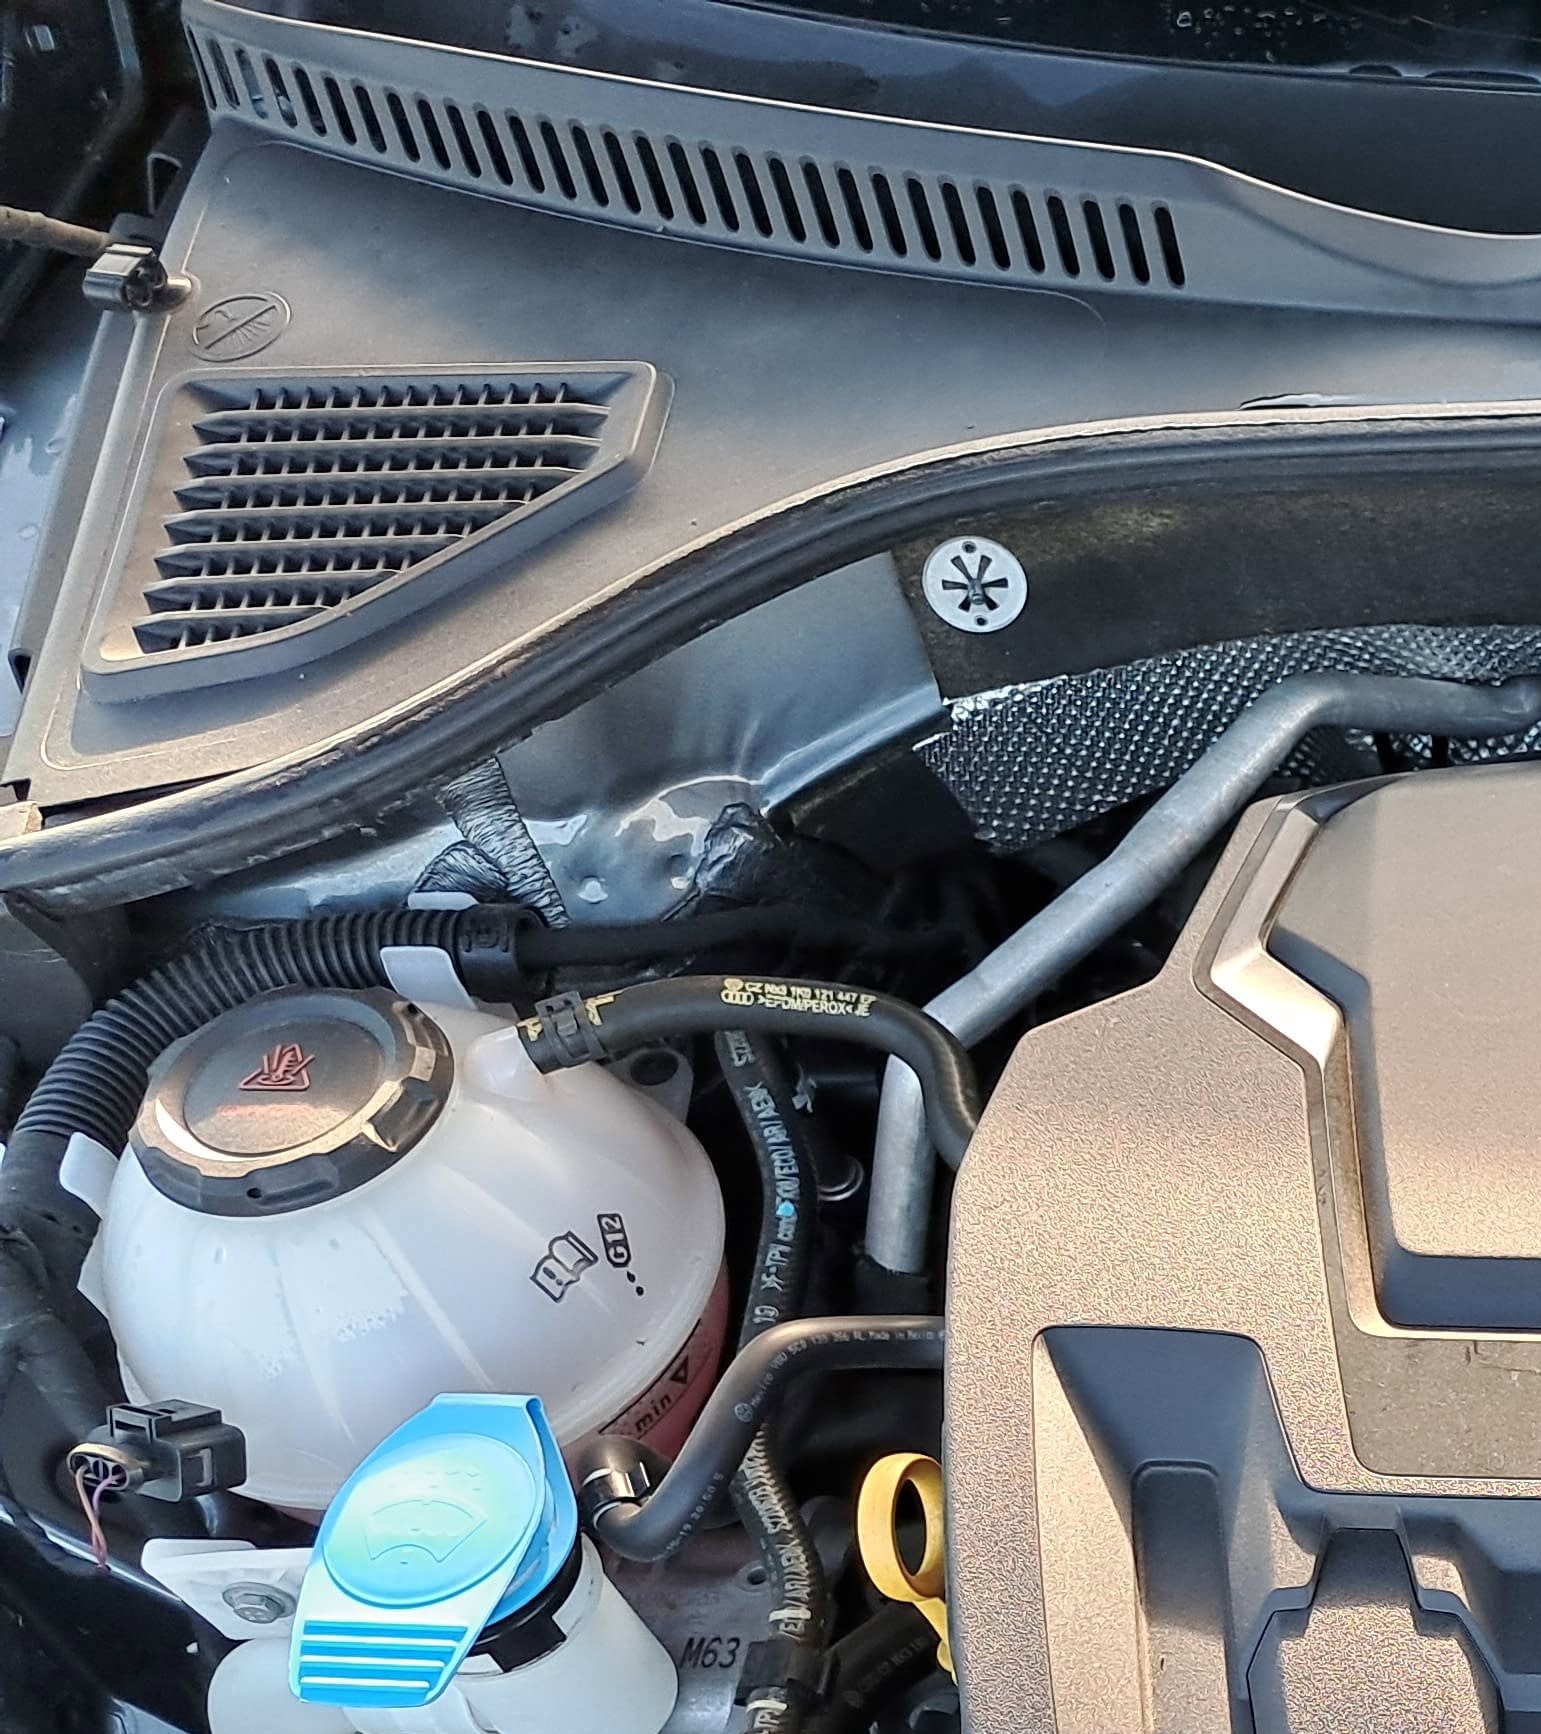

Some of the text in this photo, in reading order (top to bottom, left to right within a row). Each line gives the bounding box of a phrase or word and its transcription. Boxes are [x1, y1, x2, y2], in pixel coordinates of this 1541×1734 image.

[601, 1216, 628, 1264] G12
[635, 1393, 672, 1433] min
[679, 1637, 740, 1669] M63
